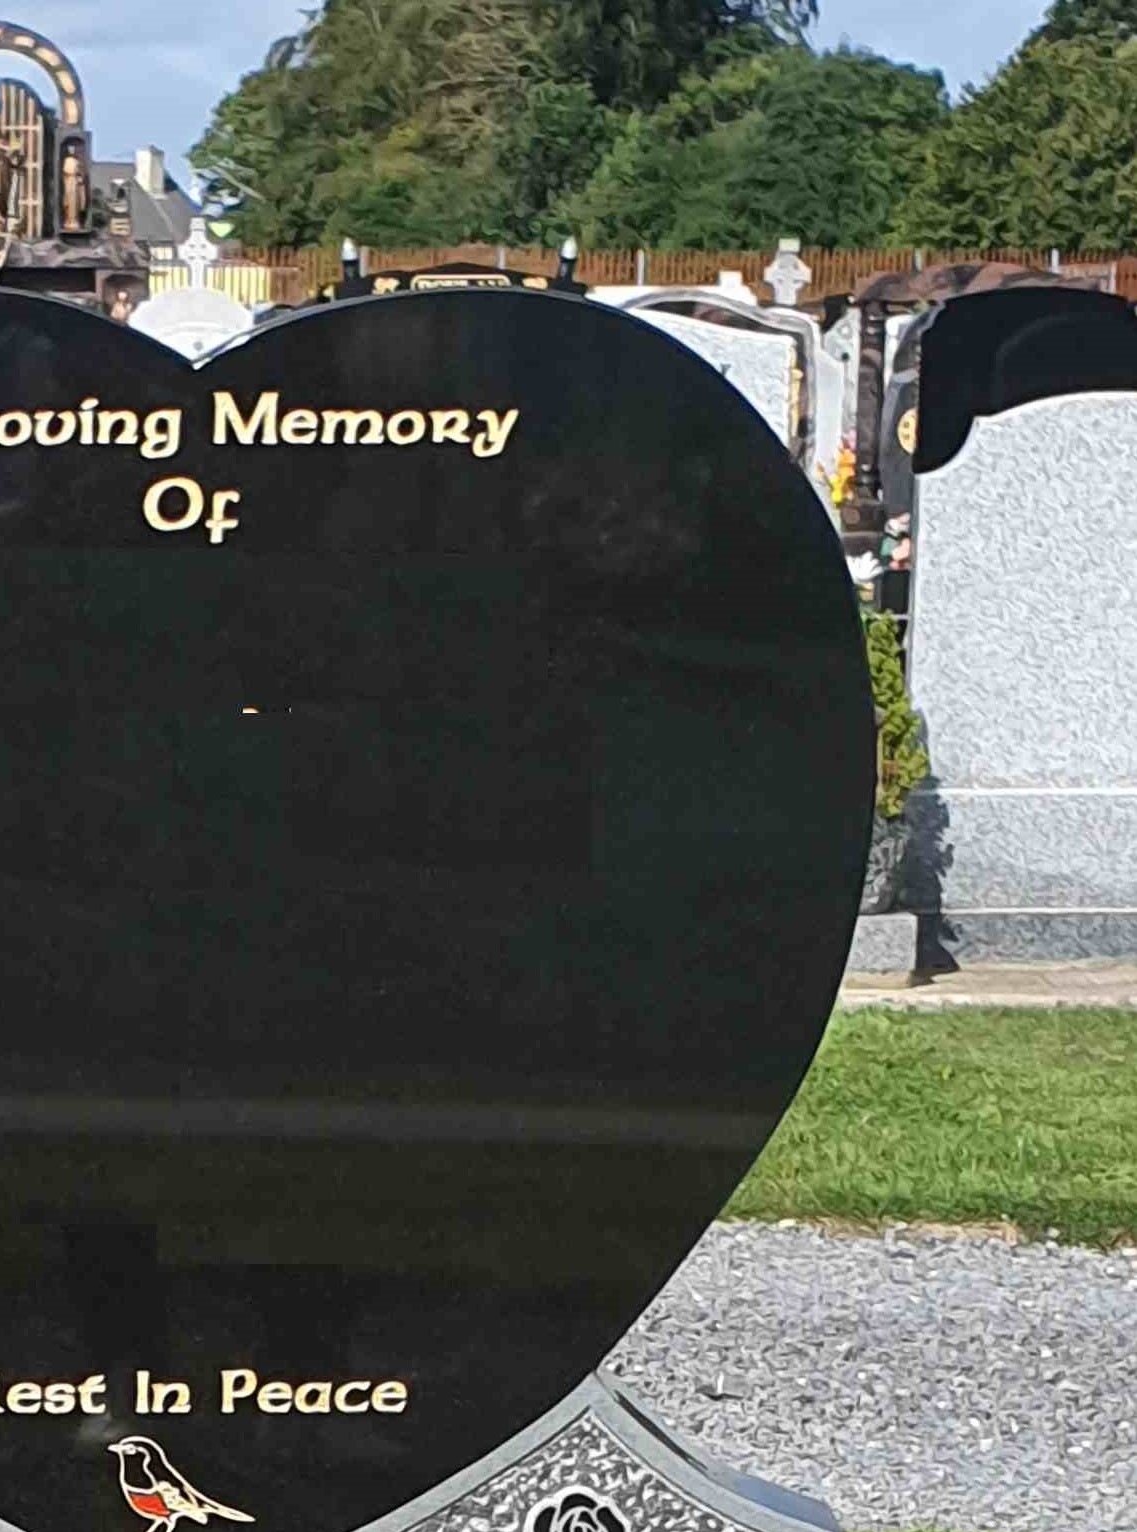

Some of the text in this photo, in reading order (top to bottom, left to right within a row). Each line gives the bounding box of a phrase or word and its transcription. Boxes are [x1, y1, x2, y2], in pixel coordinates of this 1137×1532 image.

[214, 392, 518, 457] Memory
[144, 477, 240, 543] Of
[136, 1371, 191, 1413] In
[222, 1369, 407, 1413] Peace
